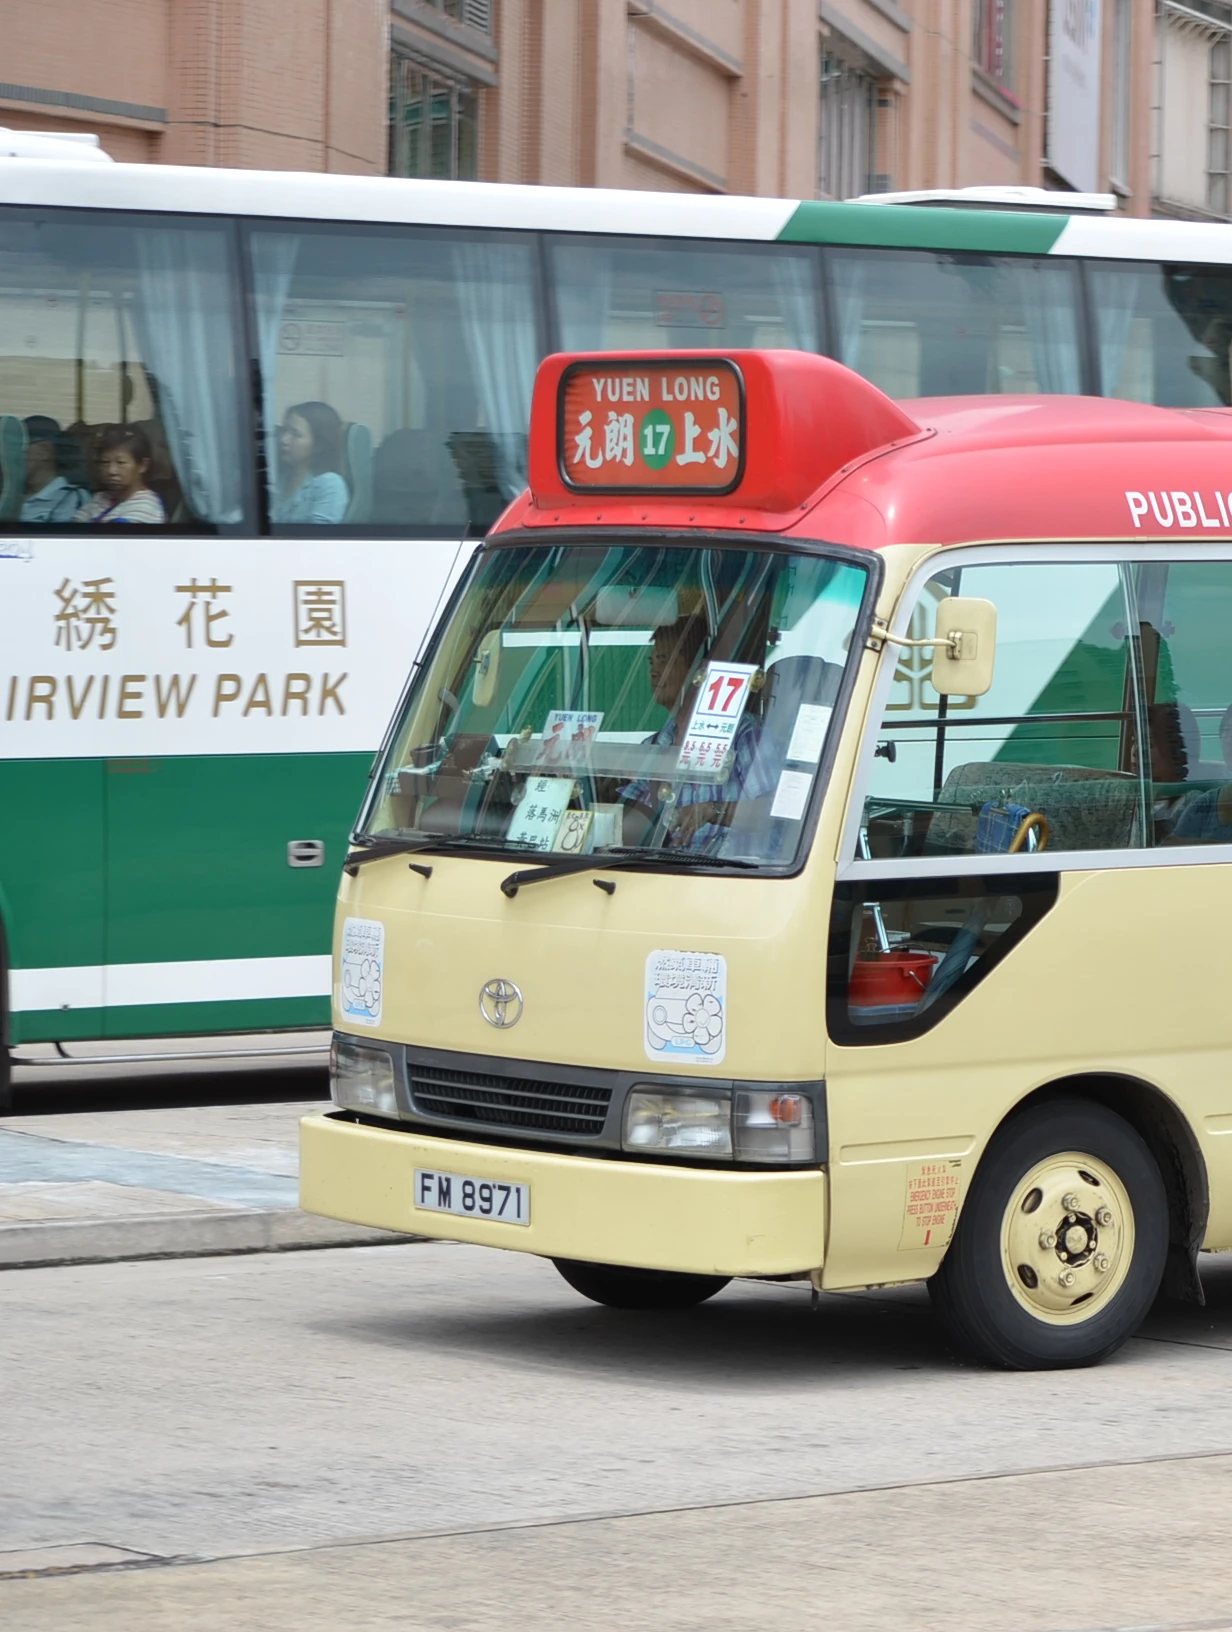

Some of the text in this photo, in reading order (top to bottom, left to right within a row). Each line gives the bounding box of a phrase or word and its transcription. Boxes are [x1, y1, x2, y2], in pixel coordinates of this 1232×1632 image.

[592, 376, 721, 402] YUEN LONG
[572, 407, 739, 469] 元朗 17 上水
[212, 672, 348, 718] PARK
[707, 675, 745, 712] 17
[554, 713, 598, 723] YUEN LONG
[421, 1172, 522, 1219] FM 8971
